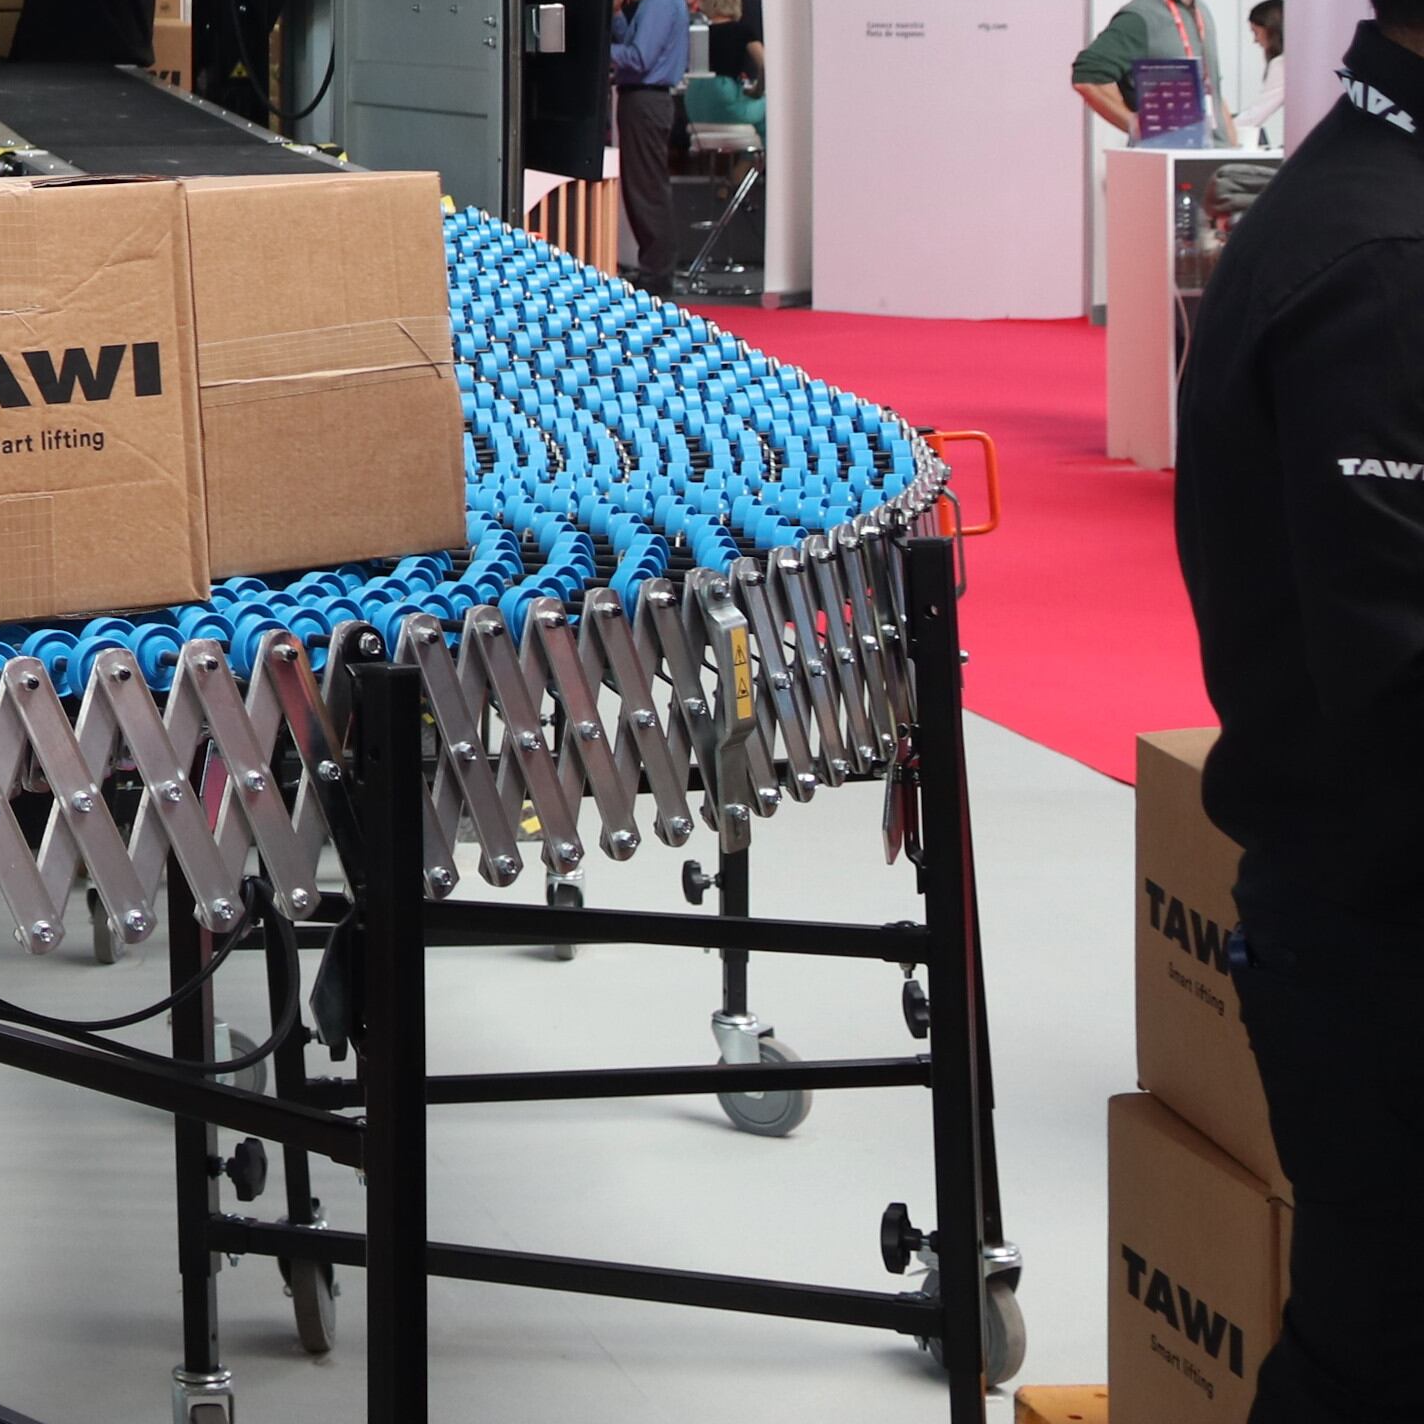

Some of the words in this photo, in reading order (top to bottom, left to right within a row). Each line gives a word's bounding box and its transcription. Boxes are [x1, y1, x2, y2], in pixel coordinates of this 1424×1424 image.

[41, 427, 105, 454] lifting
[1337, 458, 1424, 481] TAW
[1144, 877, 1233, 976] TAW
[1121, 1243, 1246, 1379] TAWI
